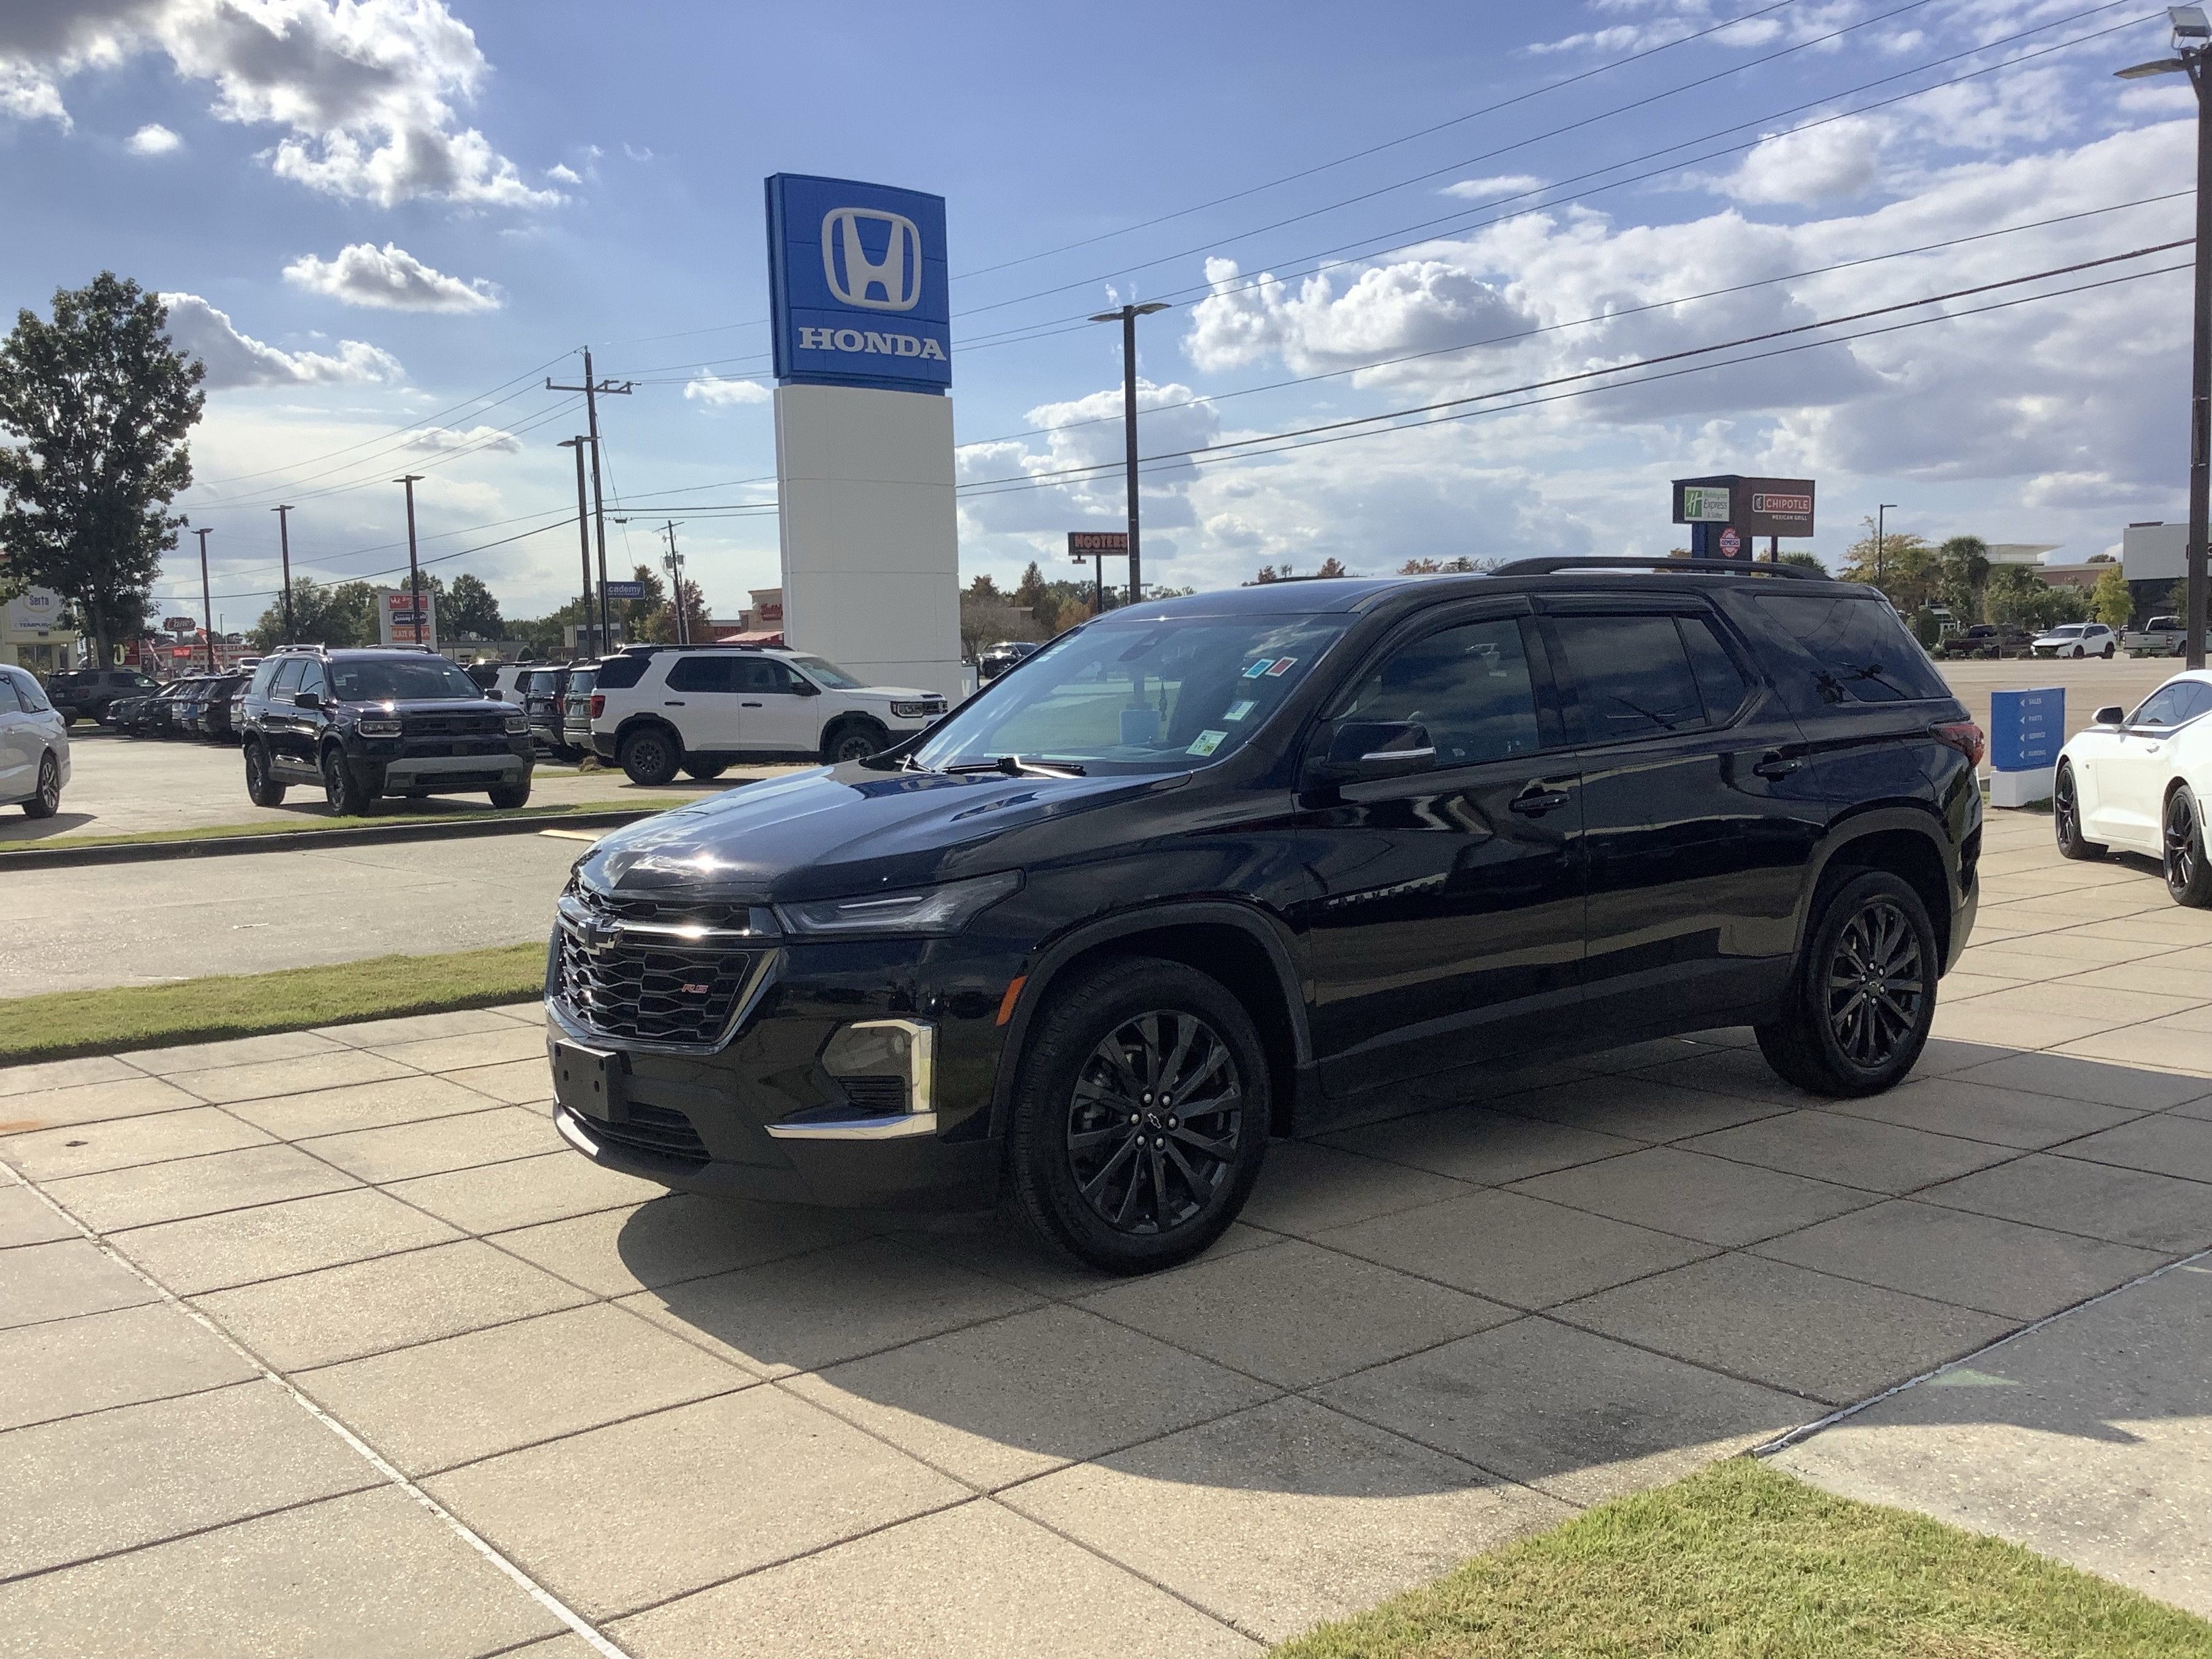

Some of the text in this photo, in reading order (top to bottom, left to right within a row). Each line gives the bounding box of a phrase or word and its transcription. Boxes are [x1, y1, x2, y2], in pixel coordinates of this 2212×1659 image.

[798, 327, 947, 361] HONDA
[1703, 499, 1727, 511] Express
[1766, 499, 1808, 509] CHIPOTLE
[1075, 534, 1127, 548] HOOTERS
[607, 585, 641, 595] cademy
[29, 595, 49, 606] Serta
[682, 983, 709, 994] RS
